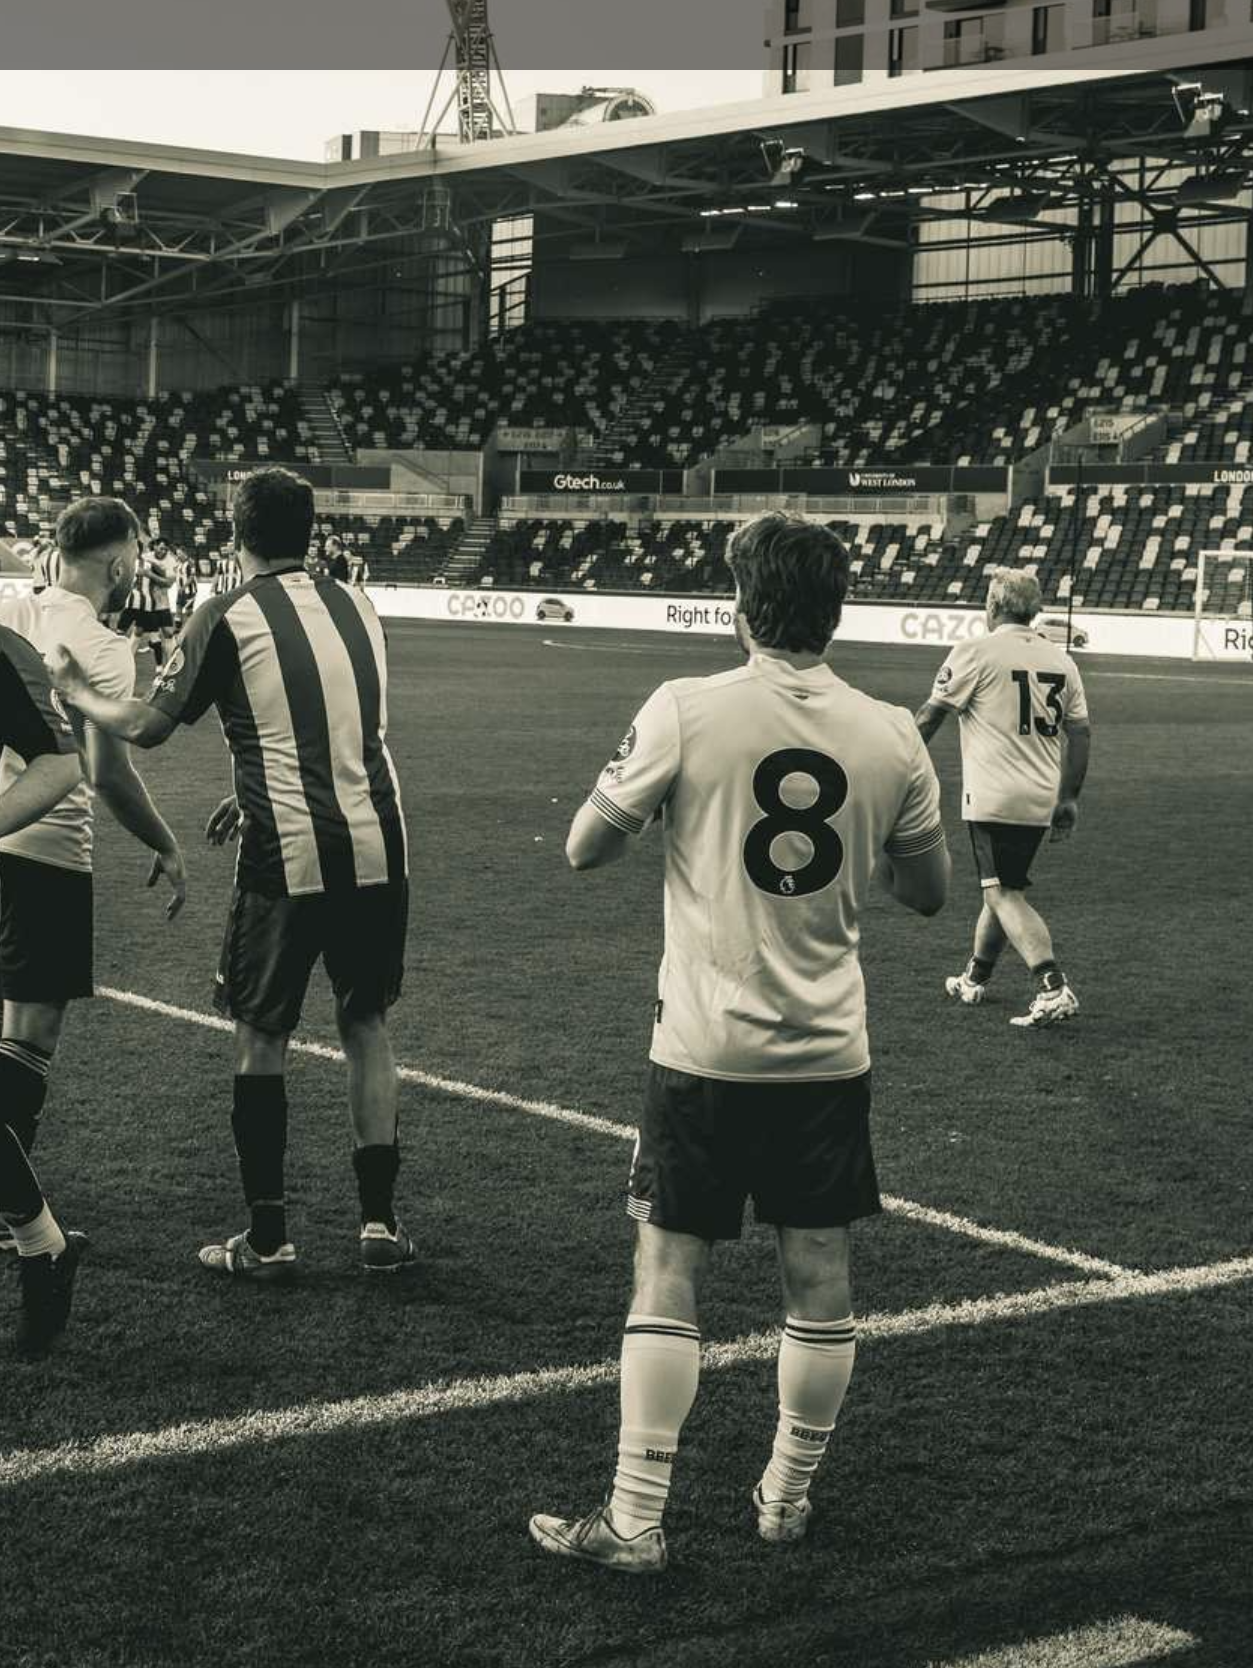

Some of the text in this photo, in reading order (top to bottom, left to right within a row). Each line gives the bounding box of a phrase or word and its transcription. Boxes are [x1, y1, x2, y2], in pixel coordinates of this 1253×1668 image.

[553, 474, 625, 490] Gtech.co.uk
[667, 605, 710, 627] Right
[1011, 670, 1066, 737] 13
[743, 748, 848, 897] 8
